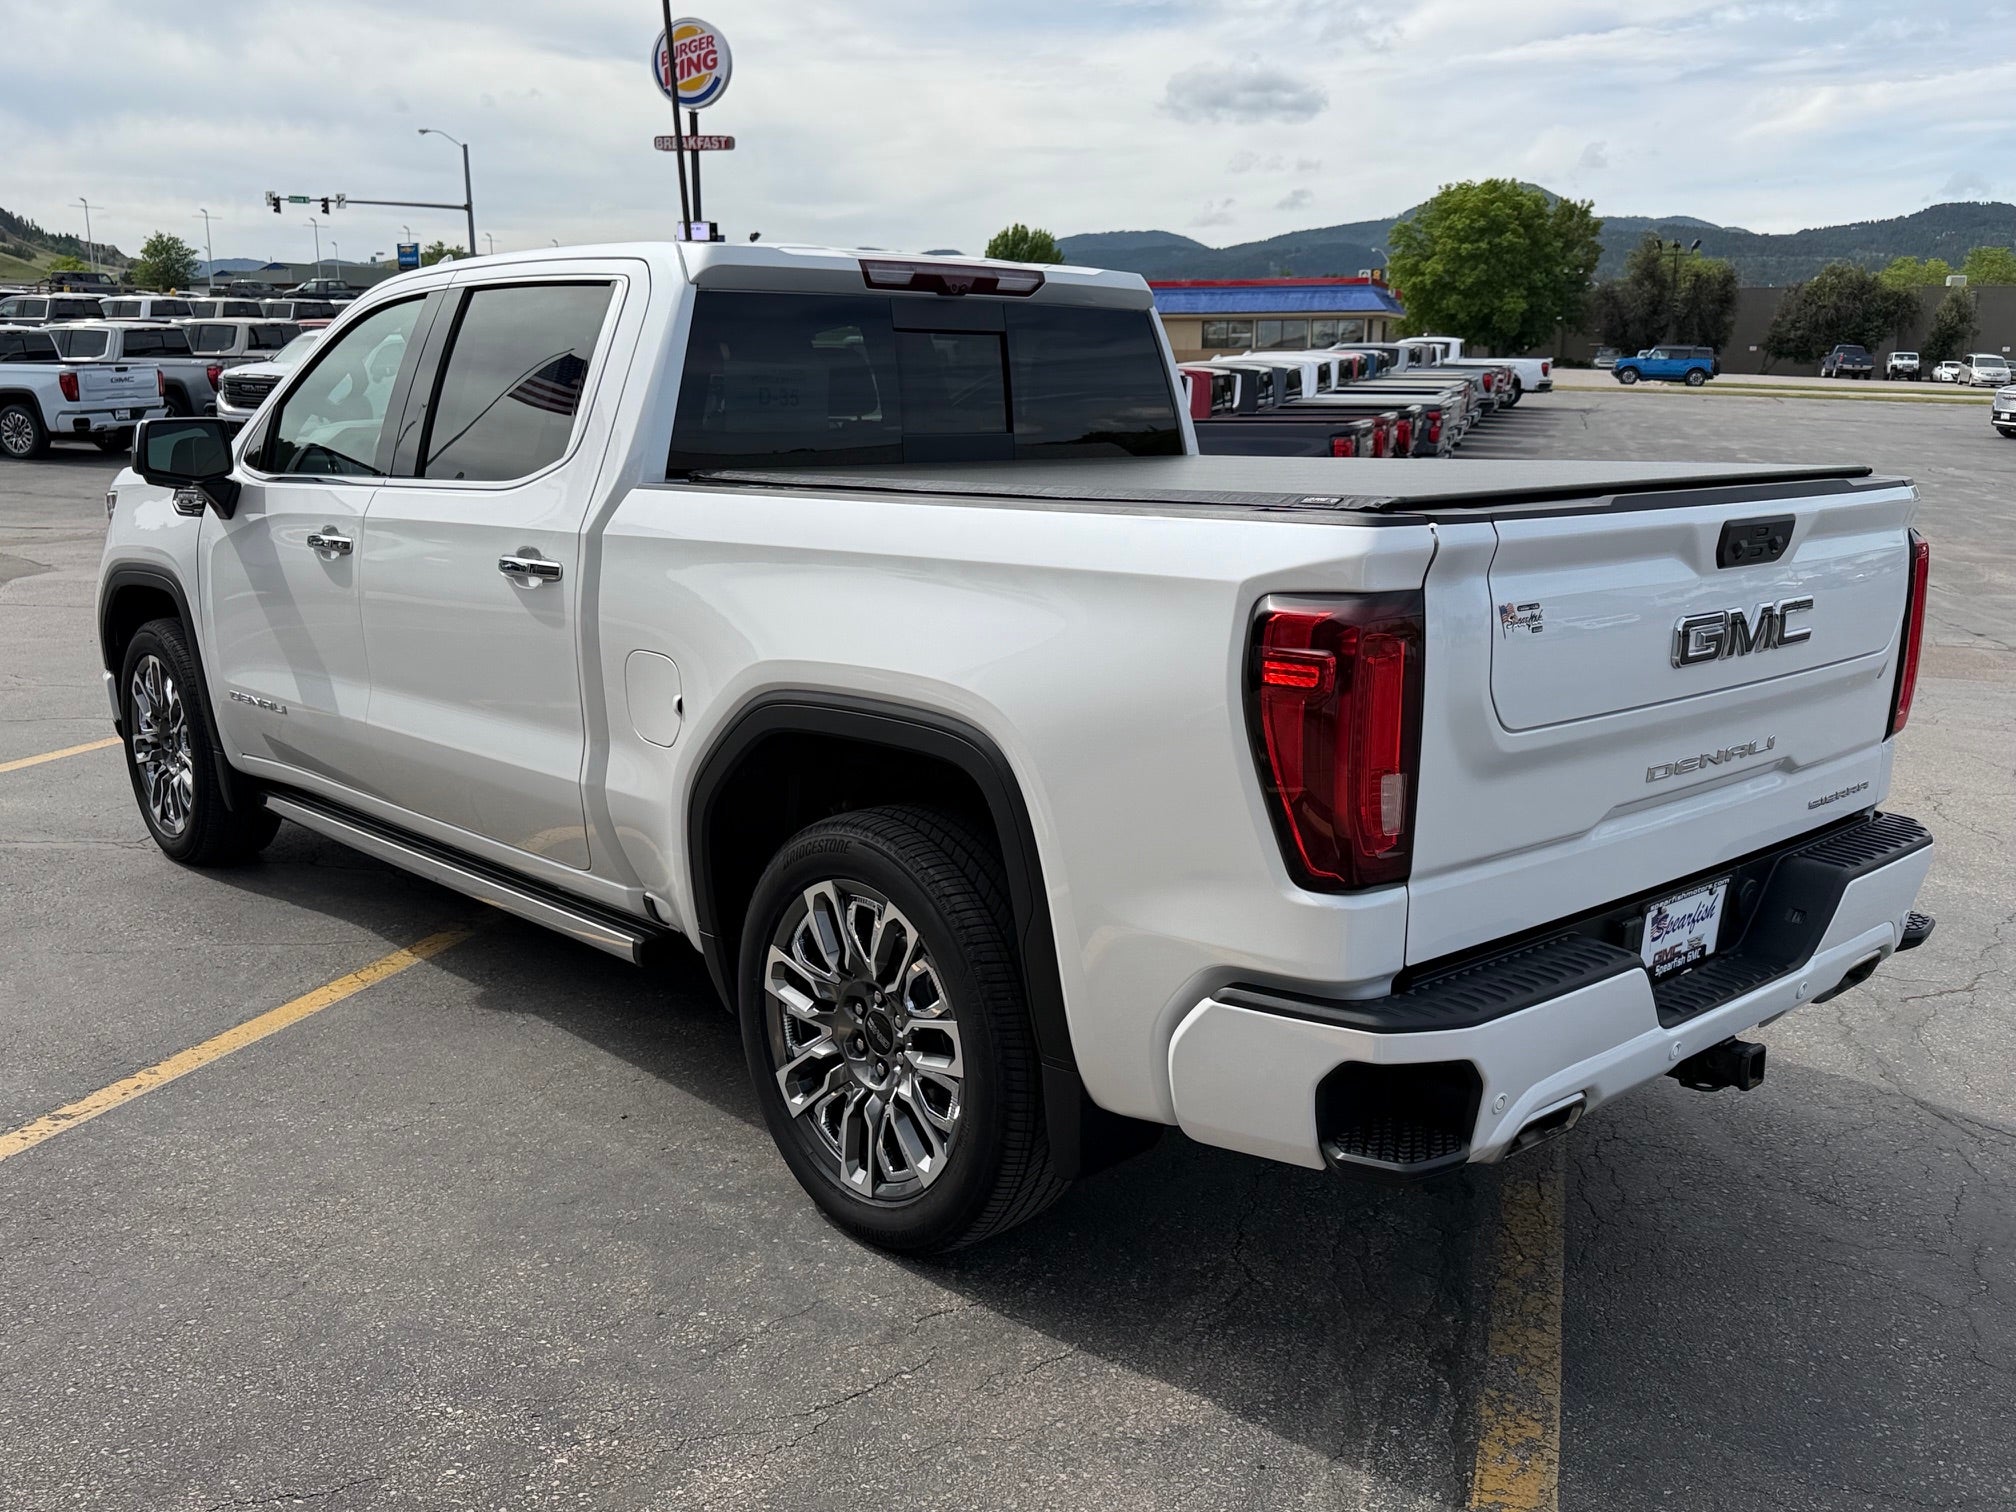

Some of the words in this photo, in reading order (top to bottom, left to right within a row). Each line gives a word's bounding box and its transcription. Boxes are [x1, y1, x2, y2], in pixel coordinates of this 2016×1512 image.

[661, 35, 715, 67] BURGER
[655, 136, 727, 150] BREAKFAST
[110, 376, 135, 384] GMC
[1671, 594, 1814, 669] GMC
[228, 689, 288, 715] DENALI
[1646, 734, 1776, 783] DENALI
[1808, 781, 1870, 810] SIERRA
[783, 838, 853, 871] BRIDGESTONE
[1650, 893, 1720, 944] Spearfish
[1654, 954, 1687, 977] Spearfish
